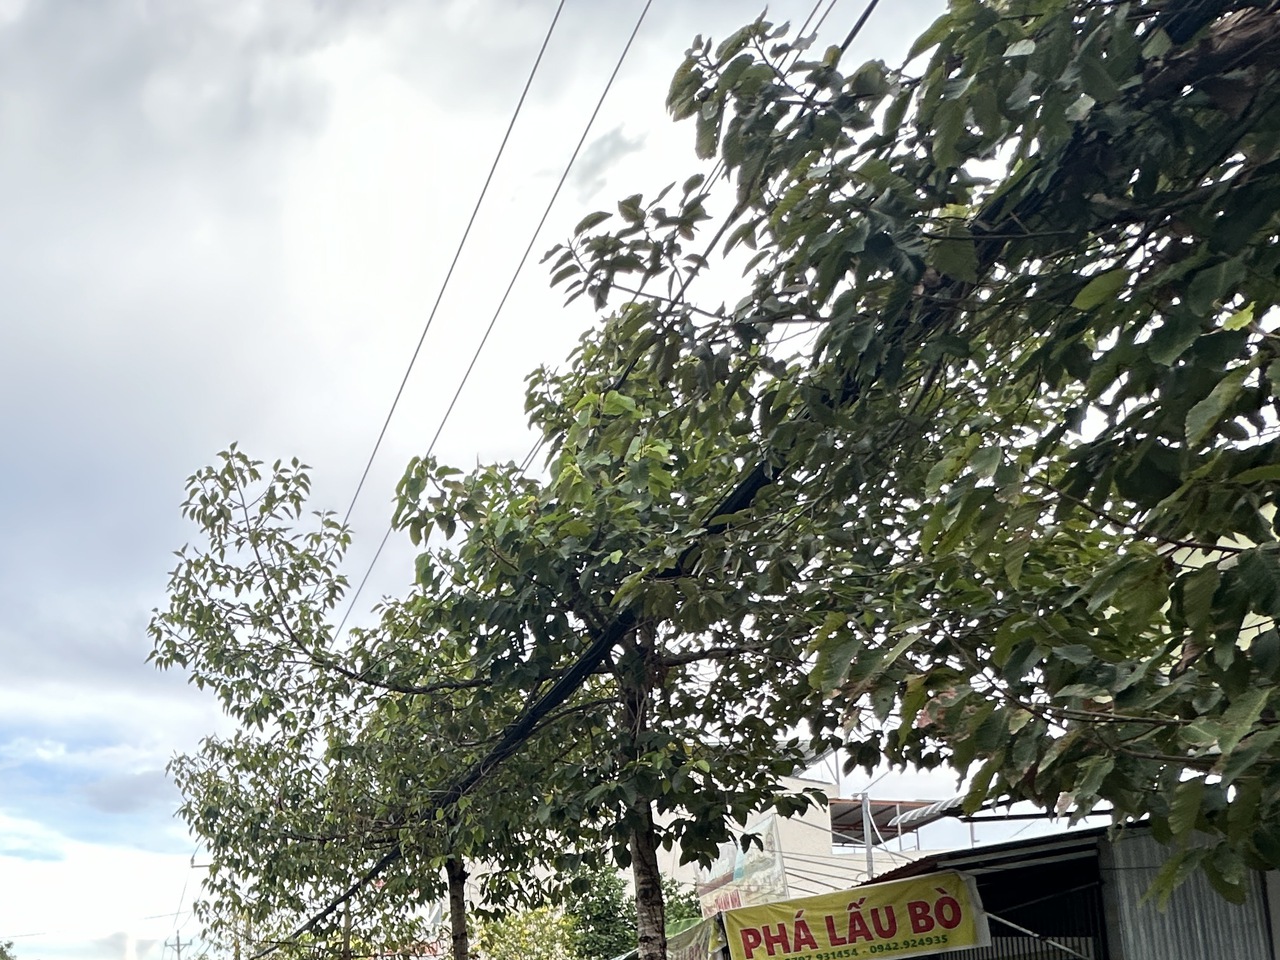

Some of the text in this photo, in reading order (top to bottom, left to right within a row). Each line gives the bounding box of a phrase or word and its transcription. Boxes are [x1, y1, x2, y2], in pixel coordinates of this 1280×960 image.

[740, 887, 962, 960] PHÁ LẤU BÒ
[870, 934, 948, 954] 0942.924935
